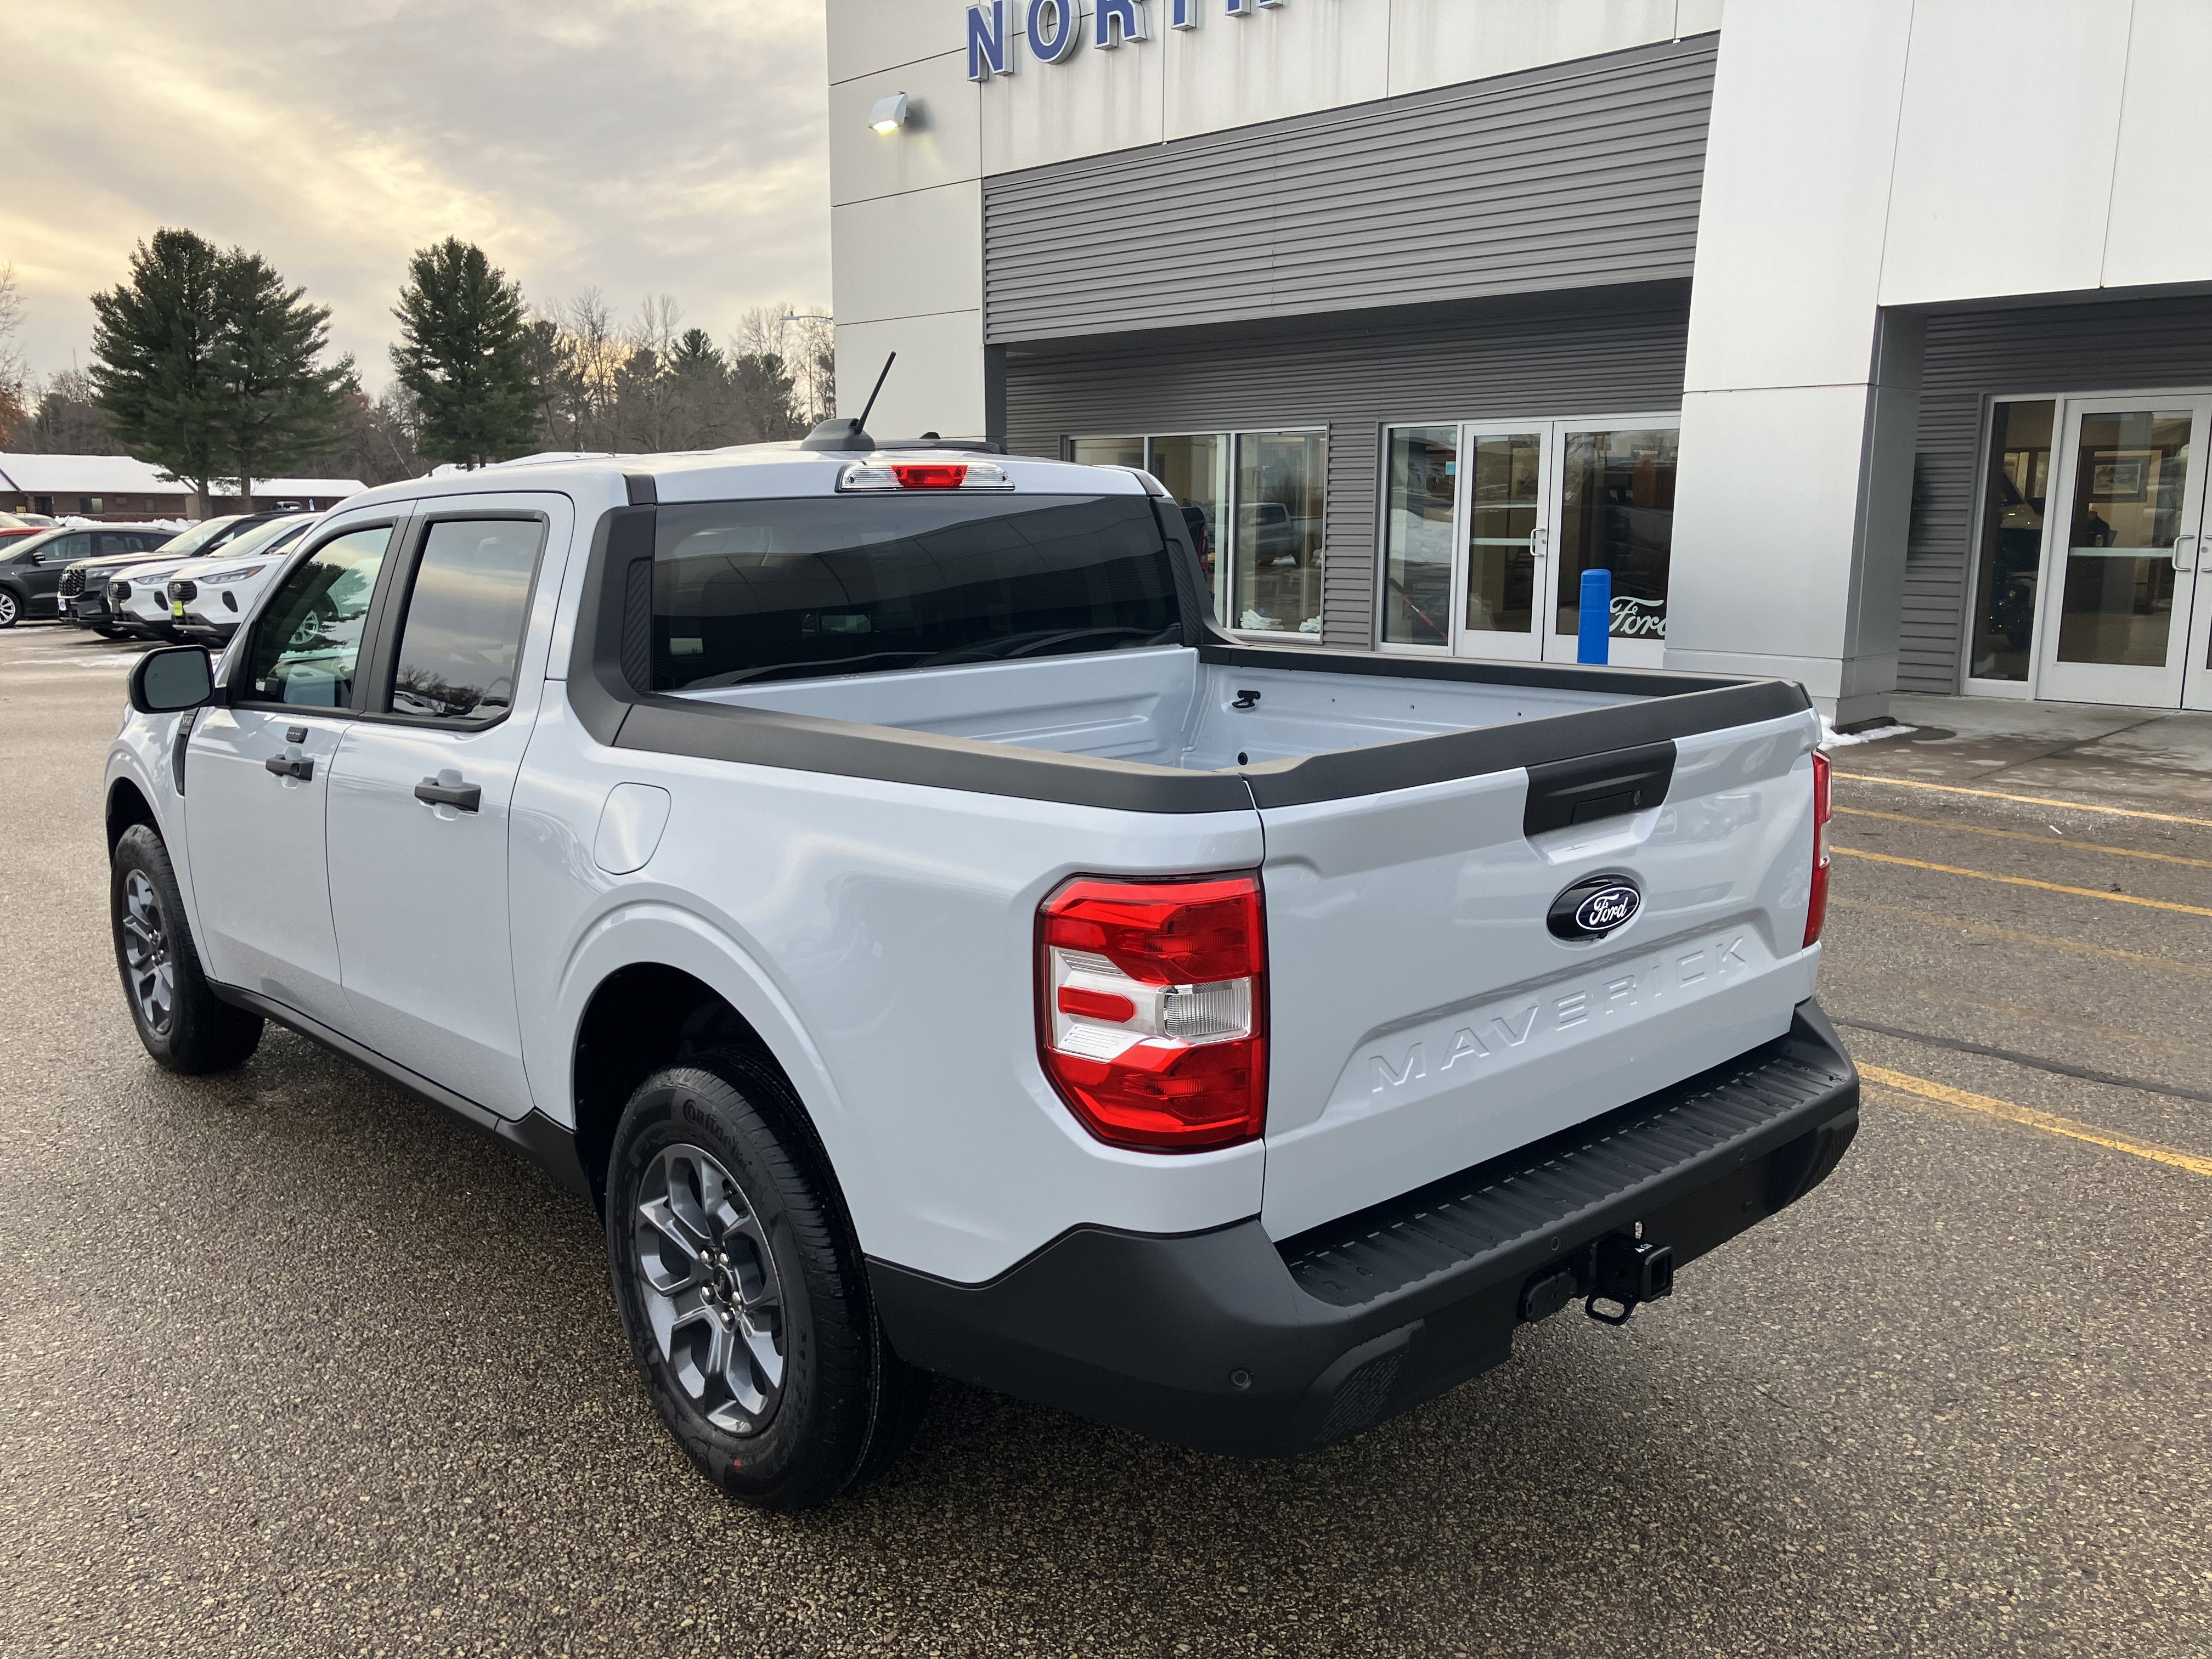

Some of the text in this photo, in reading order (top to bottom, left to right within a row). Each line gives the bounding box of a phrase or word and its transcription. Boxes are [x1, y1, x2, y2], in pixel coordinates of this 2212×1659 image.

[967, 0, 1283, 82] NOR
[1589, 893, 1628, 926] Ford
[1369, 936, 1746, 1093] MAVERICK
